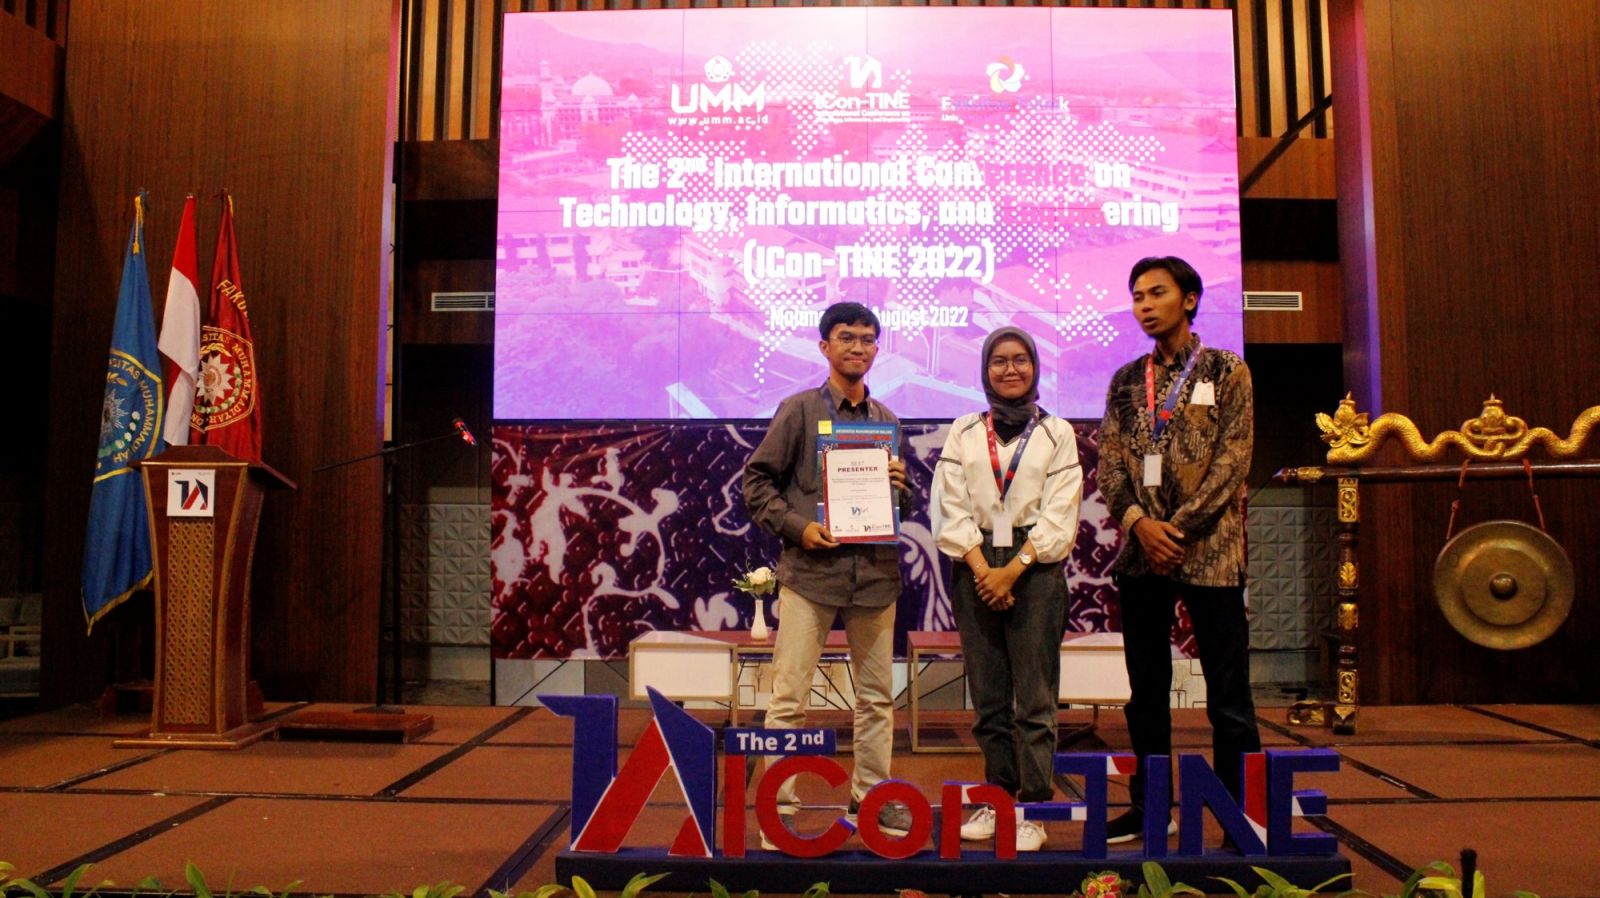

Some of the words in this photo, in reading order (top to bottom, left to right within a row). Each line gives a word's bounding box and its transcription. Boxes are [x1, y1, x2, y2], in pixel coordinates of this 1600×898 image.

[671, 82, 766, 114] UMM
[667, 114, 769, 126] www.umm.ac.id
[606, 154, 661, 189] The
[714, 155, 907, 189] International
[1094, 161, 1132, 188] on
[559, 194, 738, 233] Technology,
[747, 194, 931, 232] Informatics,
[938, 196, 996, 226] and
[1101, 194, 1179, 233] ering
[770, 304, 825, 331] Malan
[929, 306, 969, 328] 2022
[736, 732, 778, 751] The
[723, 748, 1341, 859] ICon-TINE
